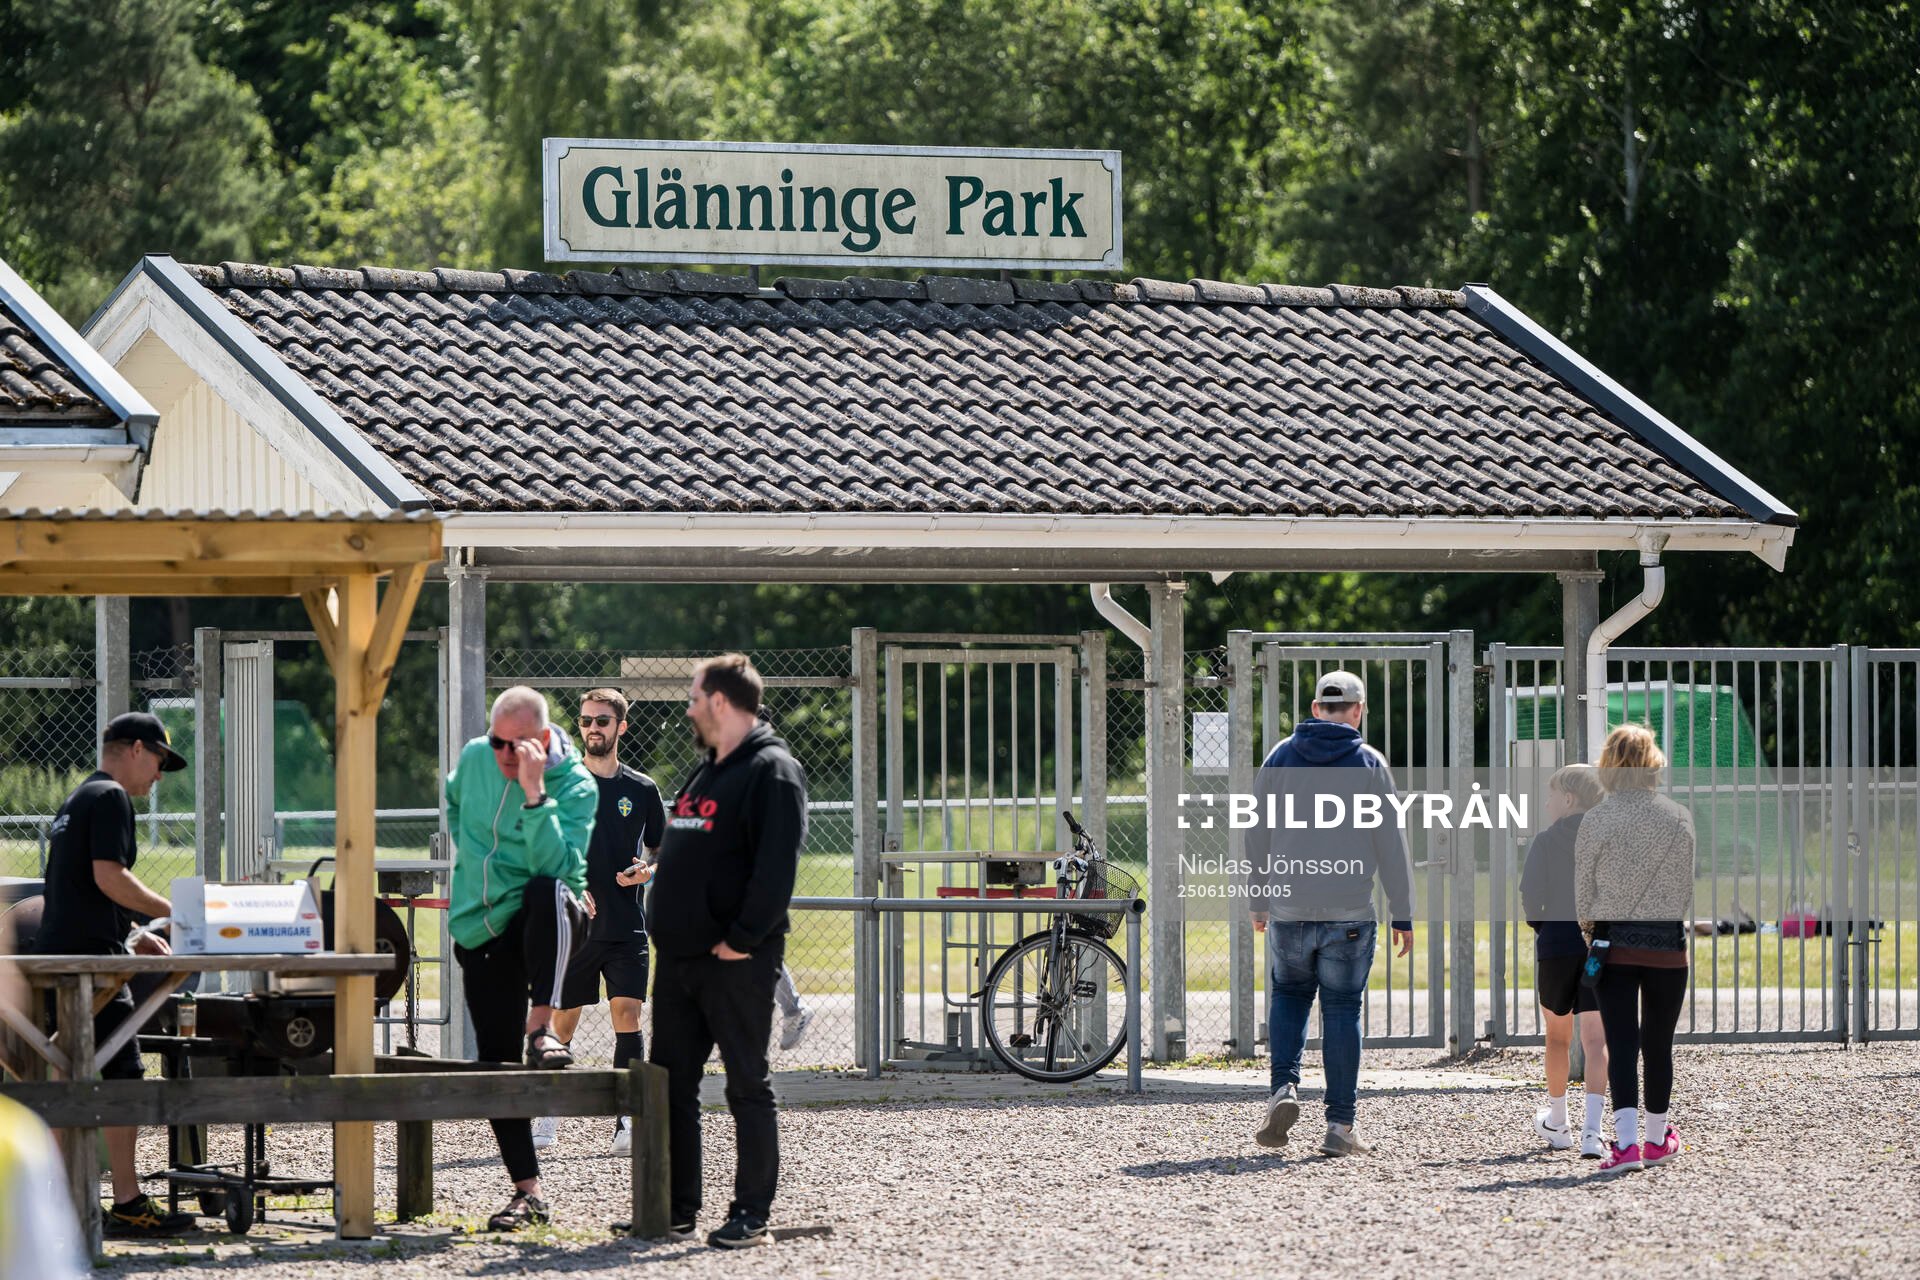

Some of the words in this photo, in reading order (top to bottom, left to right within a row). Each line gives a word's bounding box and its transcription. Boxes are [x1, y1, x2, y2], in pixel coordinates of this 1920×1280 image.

[582, 165, 916, 252] Glänninge
[945, 175, 1087, 239] Park
[248, 926, 311, 937] HAMBURGARE
